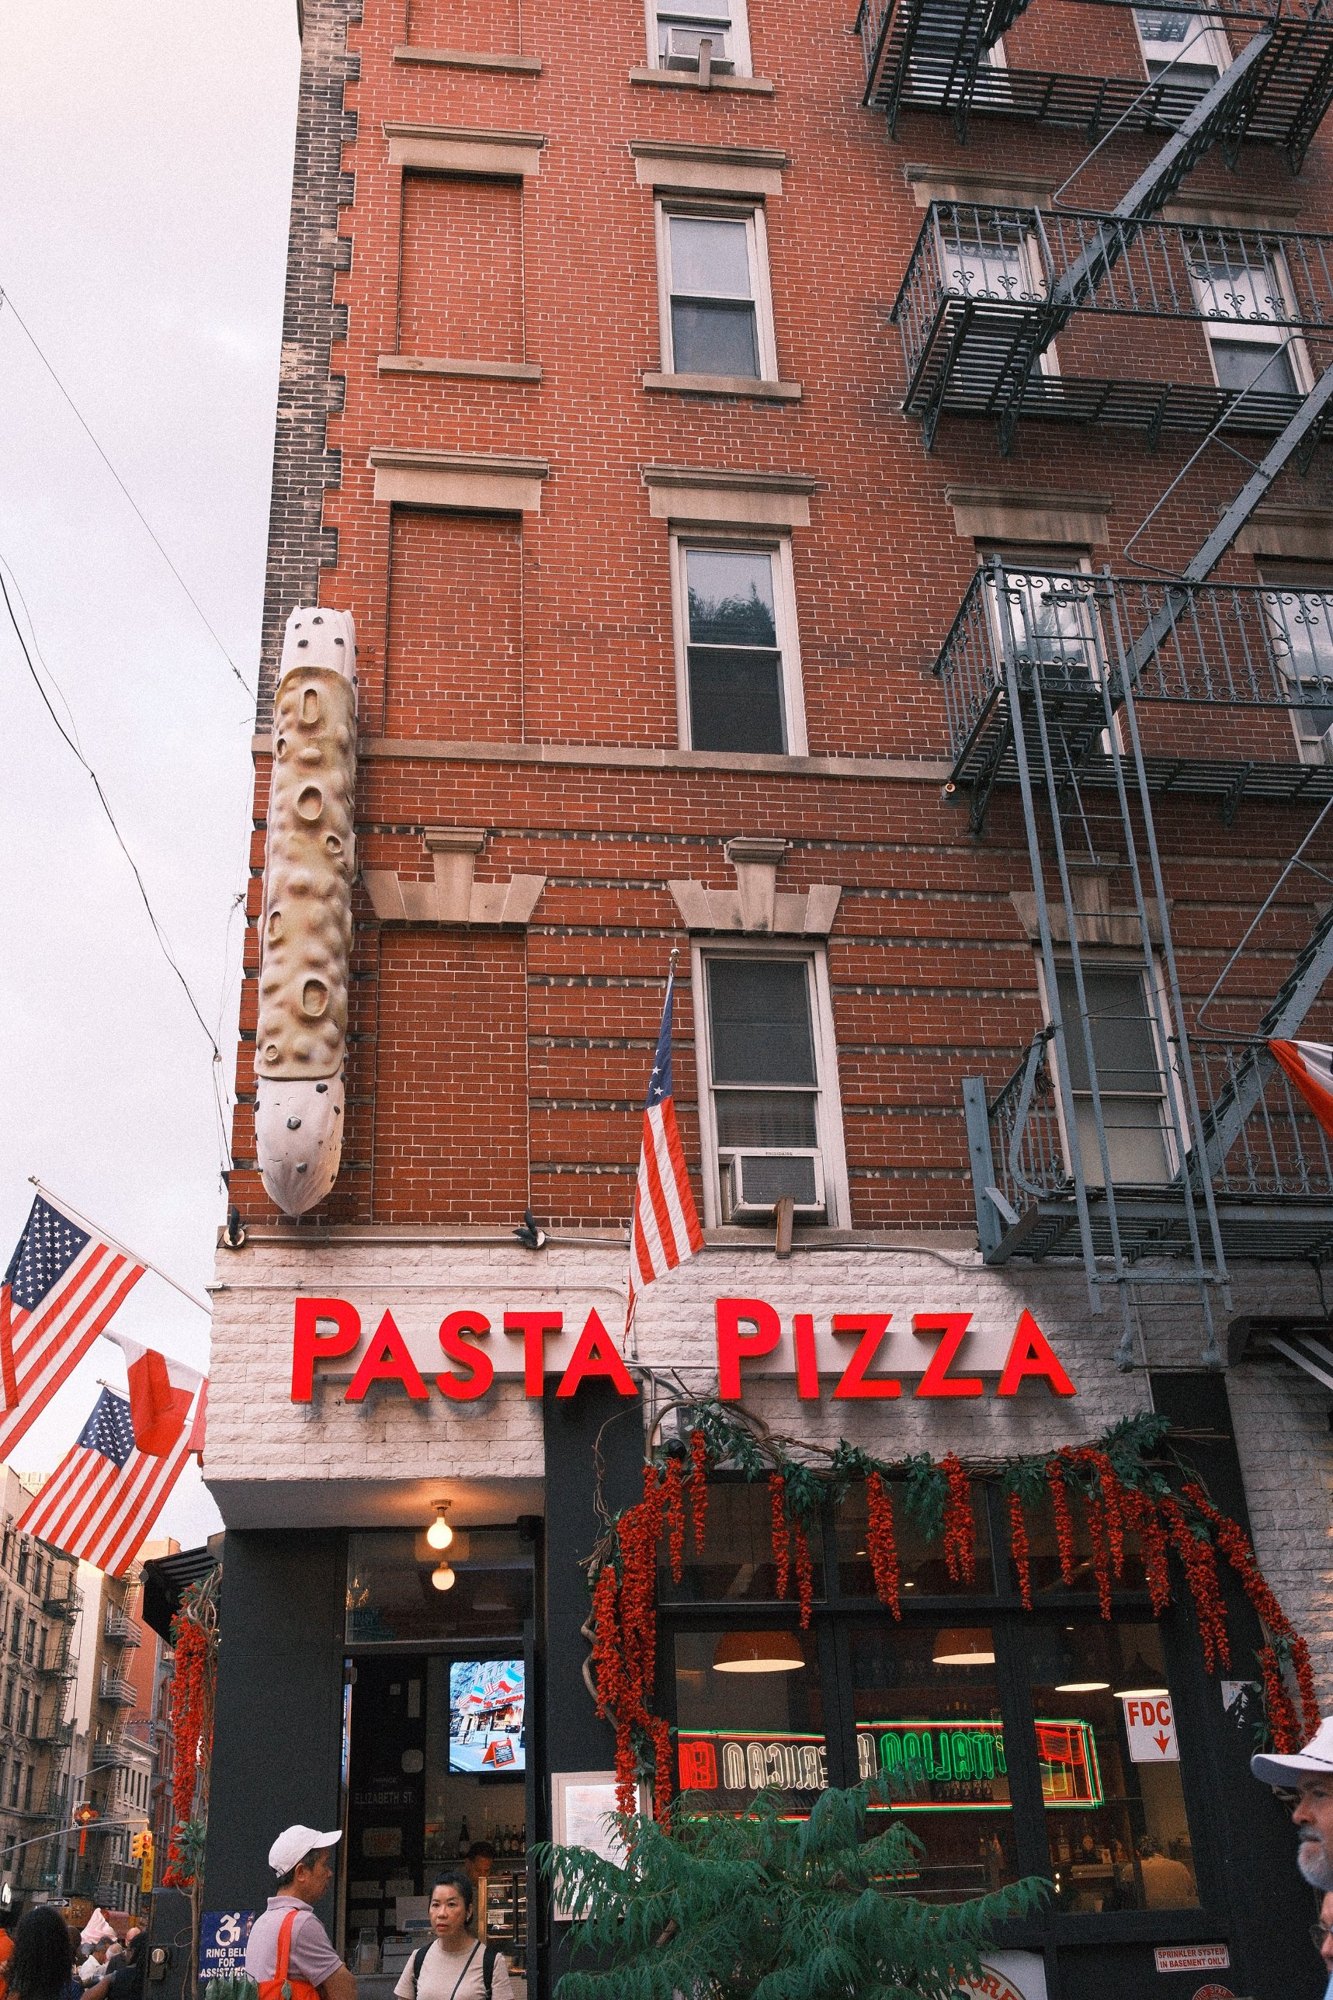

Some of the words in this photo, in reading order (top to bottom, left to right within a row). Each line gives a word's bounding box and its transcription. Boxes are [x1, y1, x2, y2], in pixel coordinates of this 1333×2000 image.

[291, 1297, 640, 1404] PASTA
[714, 1298, 1078, 1401] PIZZA
[1127, 1701, 1171, 1726] FDC
[355, 1791, 400, 1804] ELIZABETH
[206, 1948, 226, 1958] RING
[228, 1947, 247, 1958] BELL
[1157, 1949, 1197, 1959] SPRINKLER
[1198, 1947, 1225, 1957] SYSTEM
[218, 1957, 235, 1967] FOR
[1160, 1961, 1168, 1969] IN
[1169, 1958, 1206, 1968] BASEMENT
[1207, 1958, 1226, 1966] ONLY
